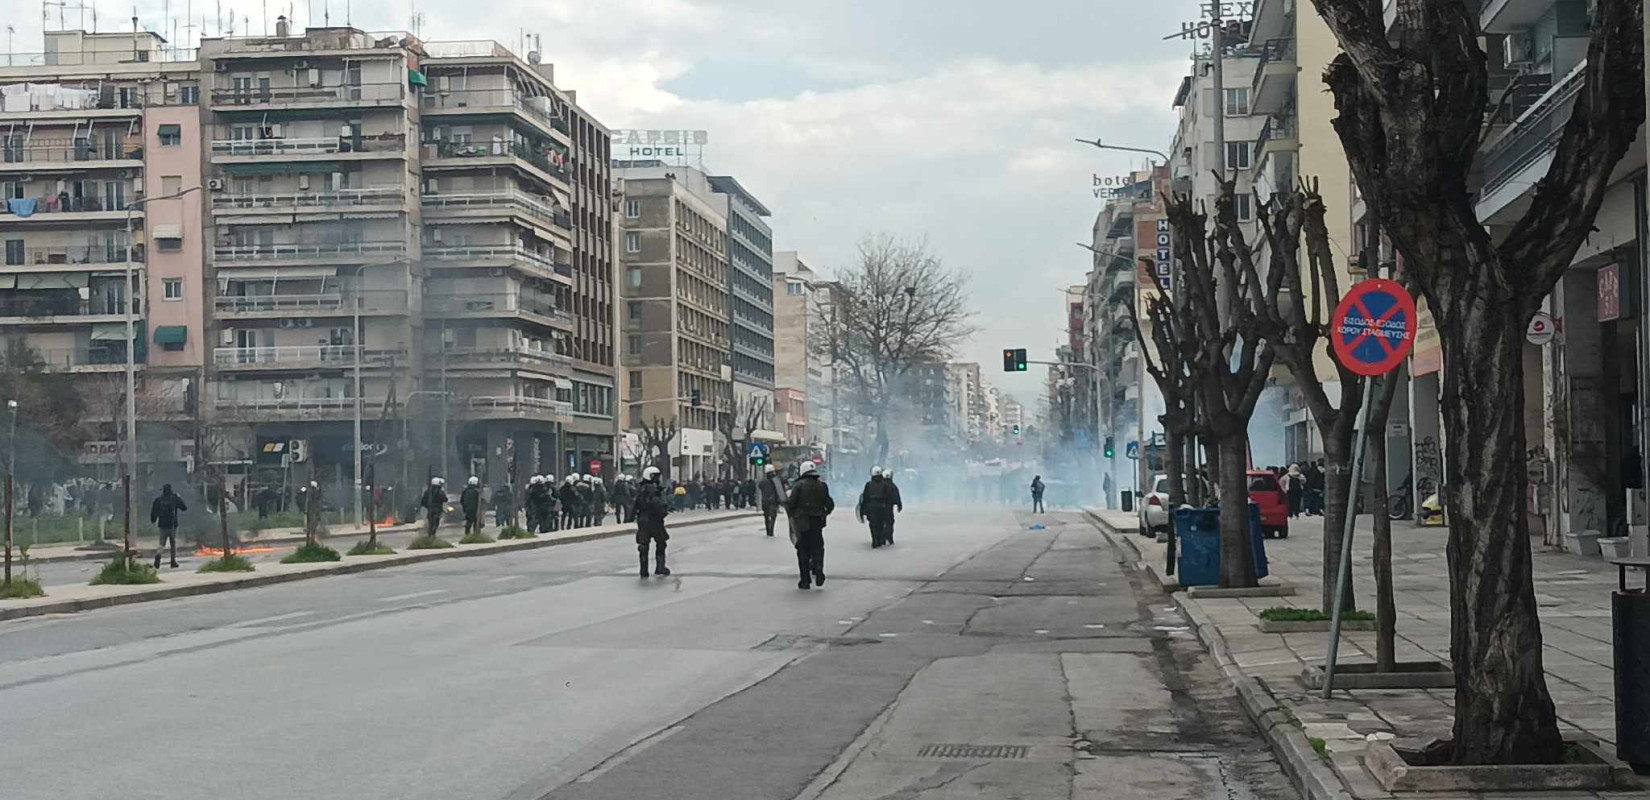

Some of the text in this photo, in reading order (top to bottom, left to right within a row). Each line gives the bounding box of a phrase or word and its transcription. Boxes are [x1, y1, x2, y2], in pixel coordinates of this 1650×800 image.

[1200, 2, 1253, 18] REX
[630, 147, 684, 156] HOTEL
[1158, 220, 1169, 288] HOTEL
